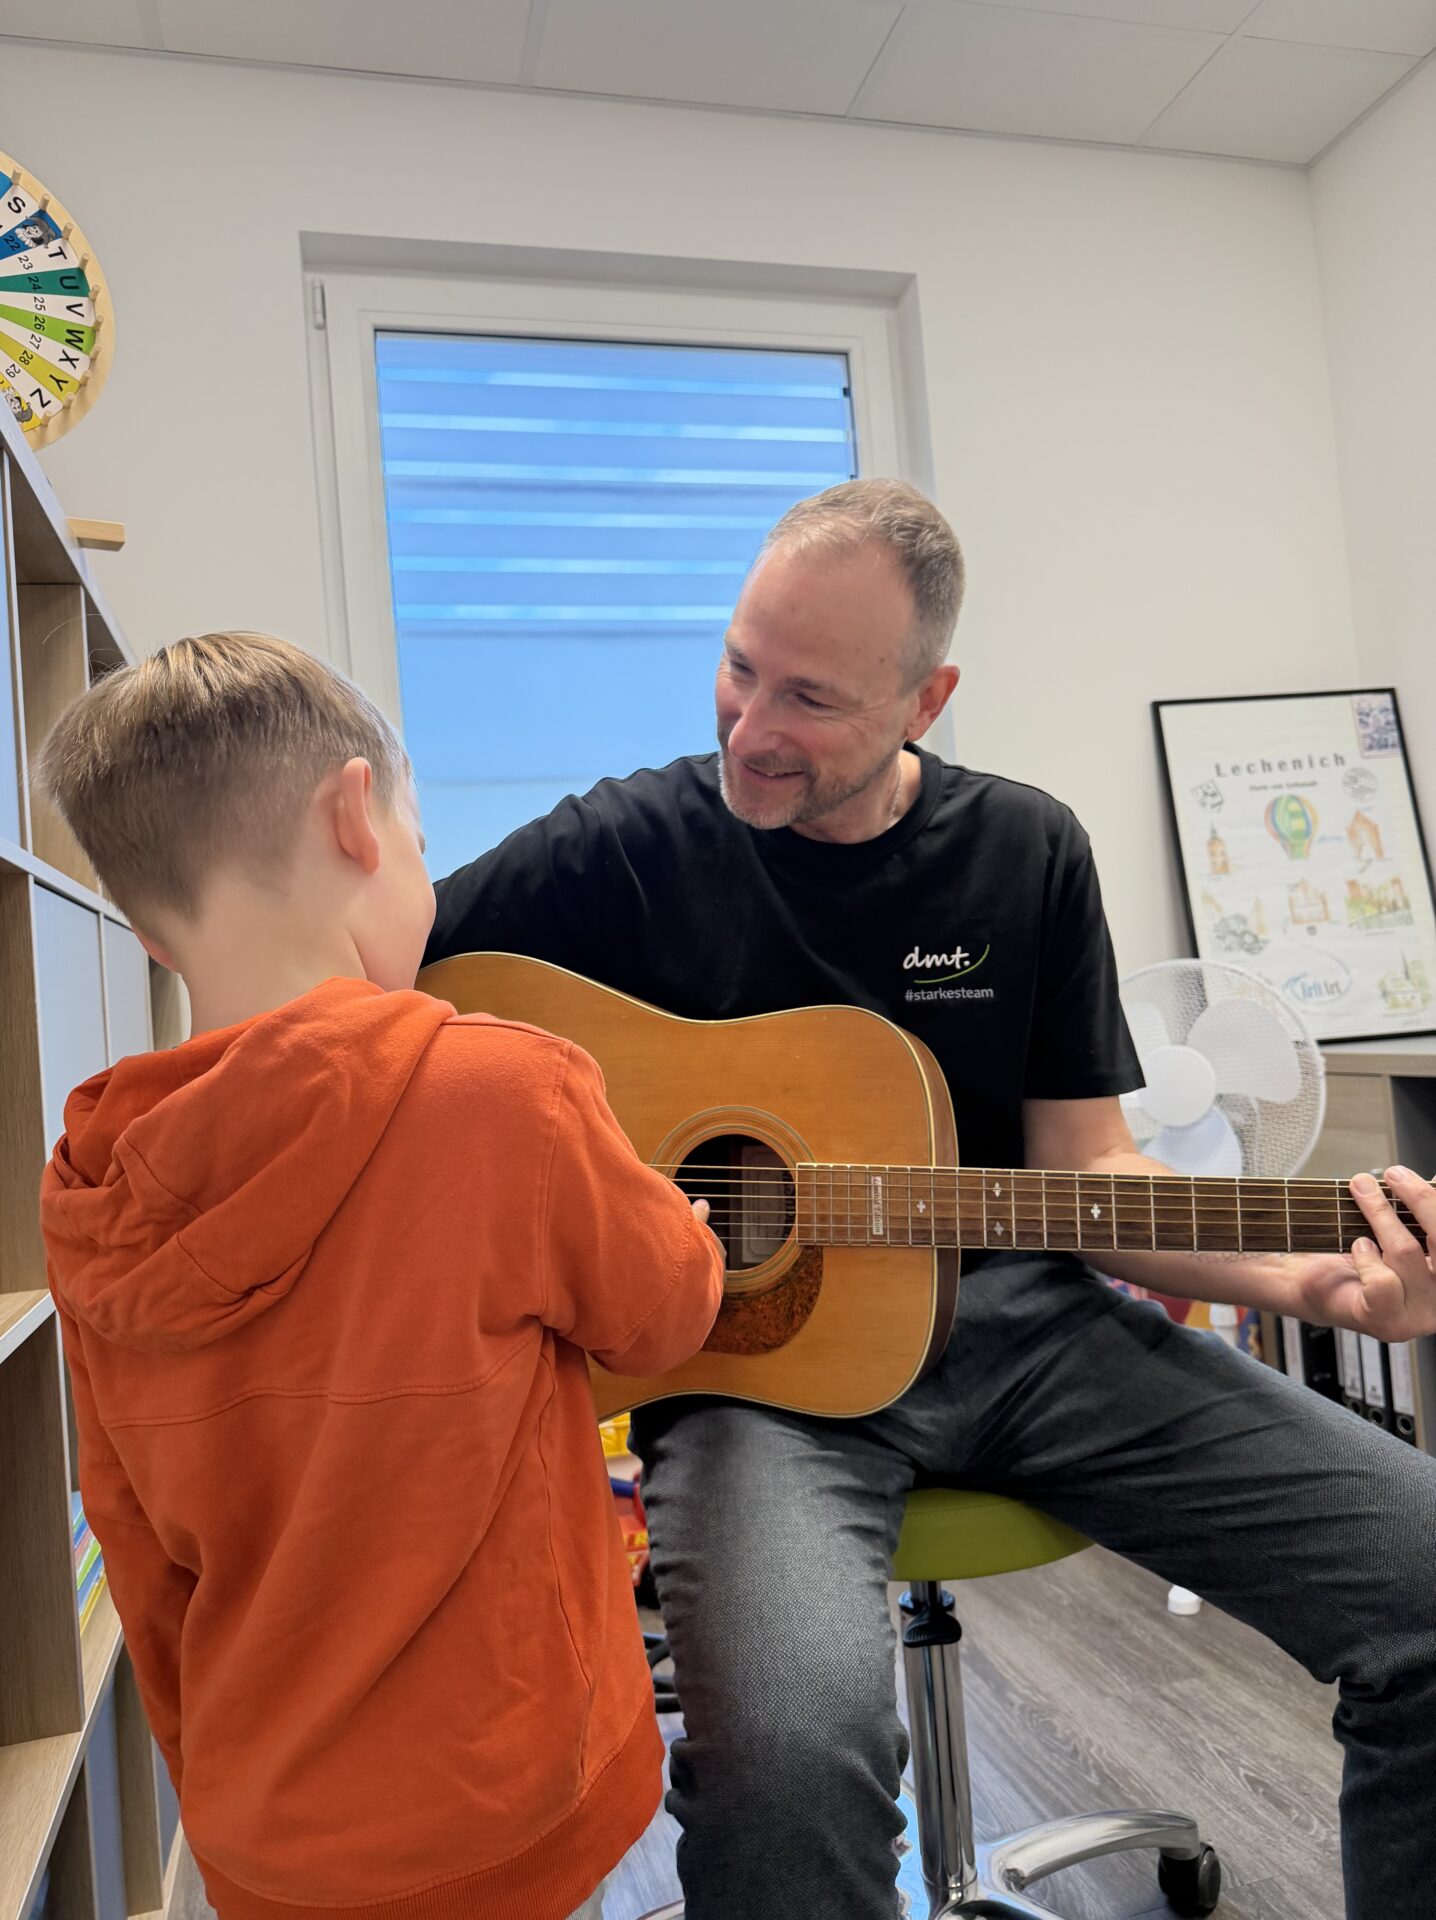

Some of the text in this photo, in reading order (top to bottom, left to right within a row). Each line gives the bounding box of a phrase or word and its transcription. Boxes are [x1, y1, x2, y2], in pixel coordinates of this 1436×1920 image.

[8, 196, 26, 214] S
[4, 235, 21, 251] 22
[48, 246, 68, 260] T
[18, 255, 33, 270] 23
[28, 276, 42, 291] 24
[59, 275, 80, 290] U
[33, 296, 46, 312] 25
[66, 303, 85, 318] V
[34, 315, 46, 331] 26
[29, 333, 42, 350] 27
[65, 329, 85, 351] W
[19, 350, 34, 366] 28
[58, 349, 80, 369] X
[5, 363, 21, 378] 29
[49, 374, 69, 392] Y
[29, 388, 52, 408] Z
[1215, 753, 1345, 778] Lechenich
[904, 987, 994, 1001] #starkesteam
